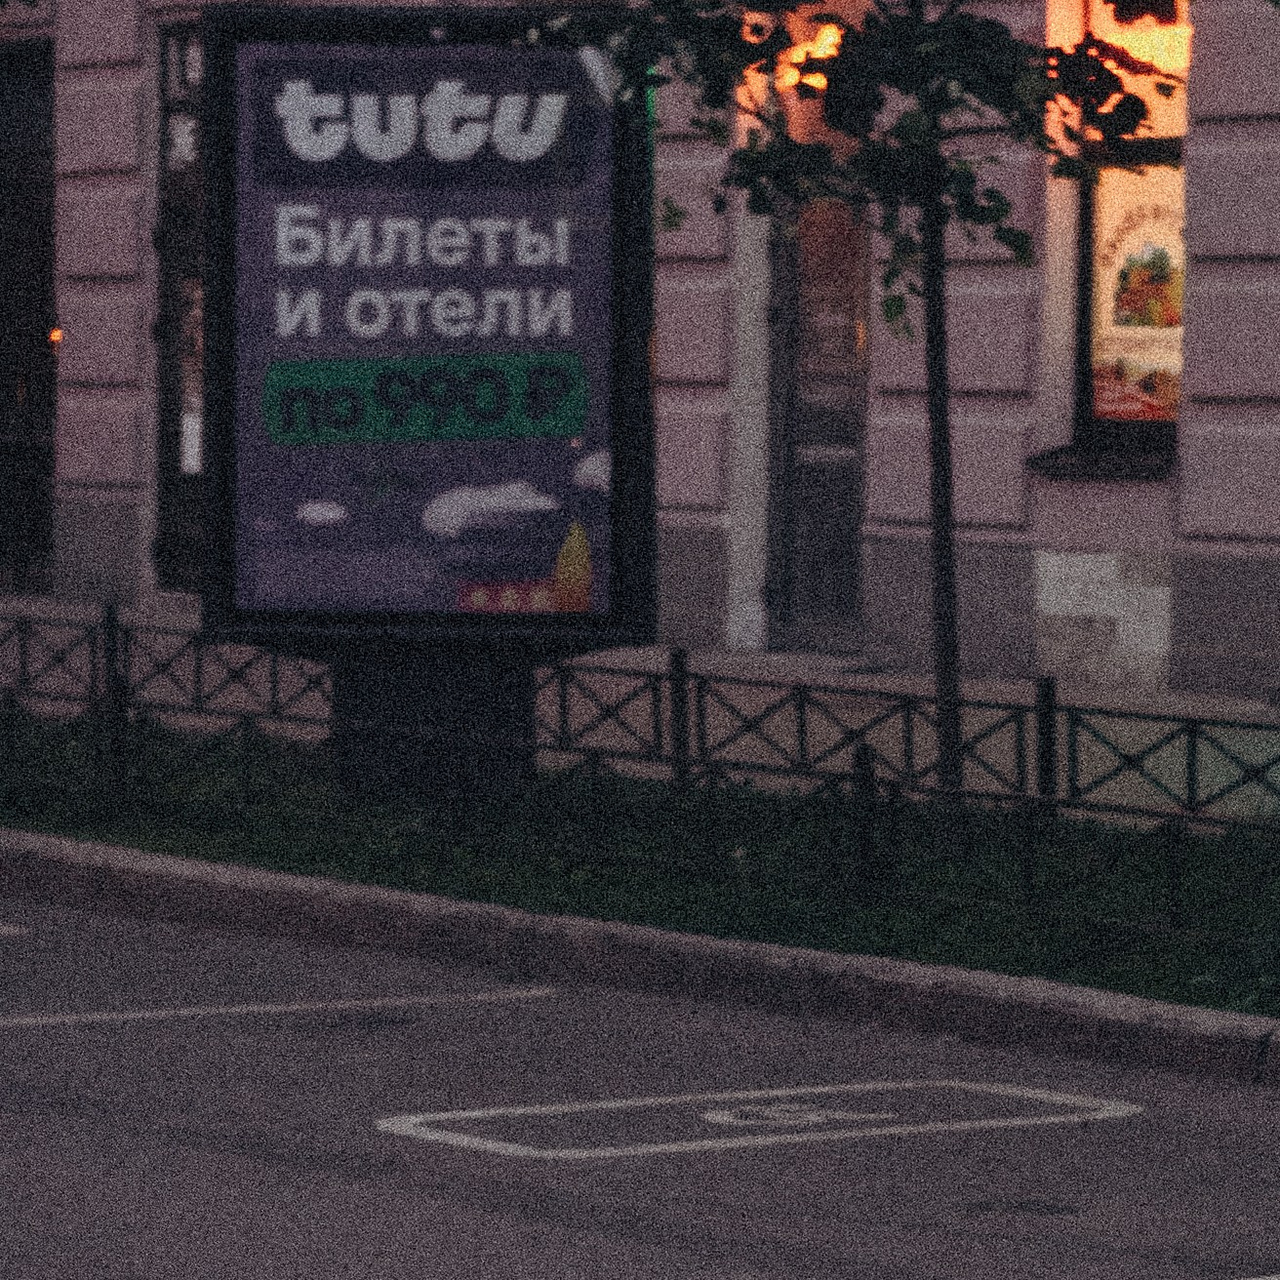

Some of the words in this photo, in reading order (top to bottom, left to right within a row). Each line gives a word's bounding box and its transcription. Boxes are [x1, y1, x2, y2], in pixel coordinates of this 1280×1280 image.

[275, 80, 568, 162] tutu
[275, 205, 569, 267] Билеты
[275, 287, 322, 338] и
[346, 287, 574, 339] отели
[279, 384, 364, 432] по
[376, 367, 509, 425] 990
